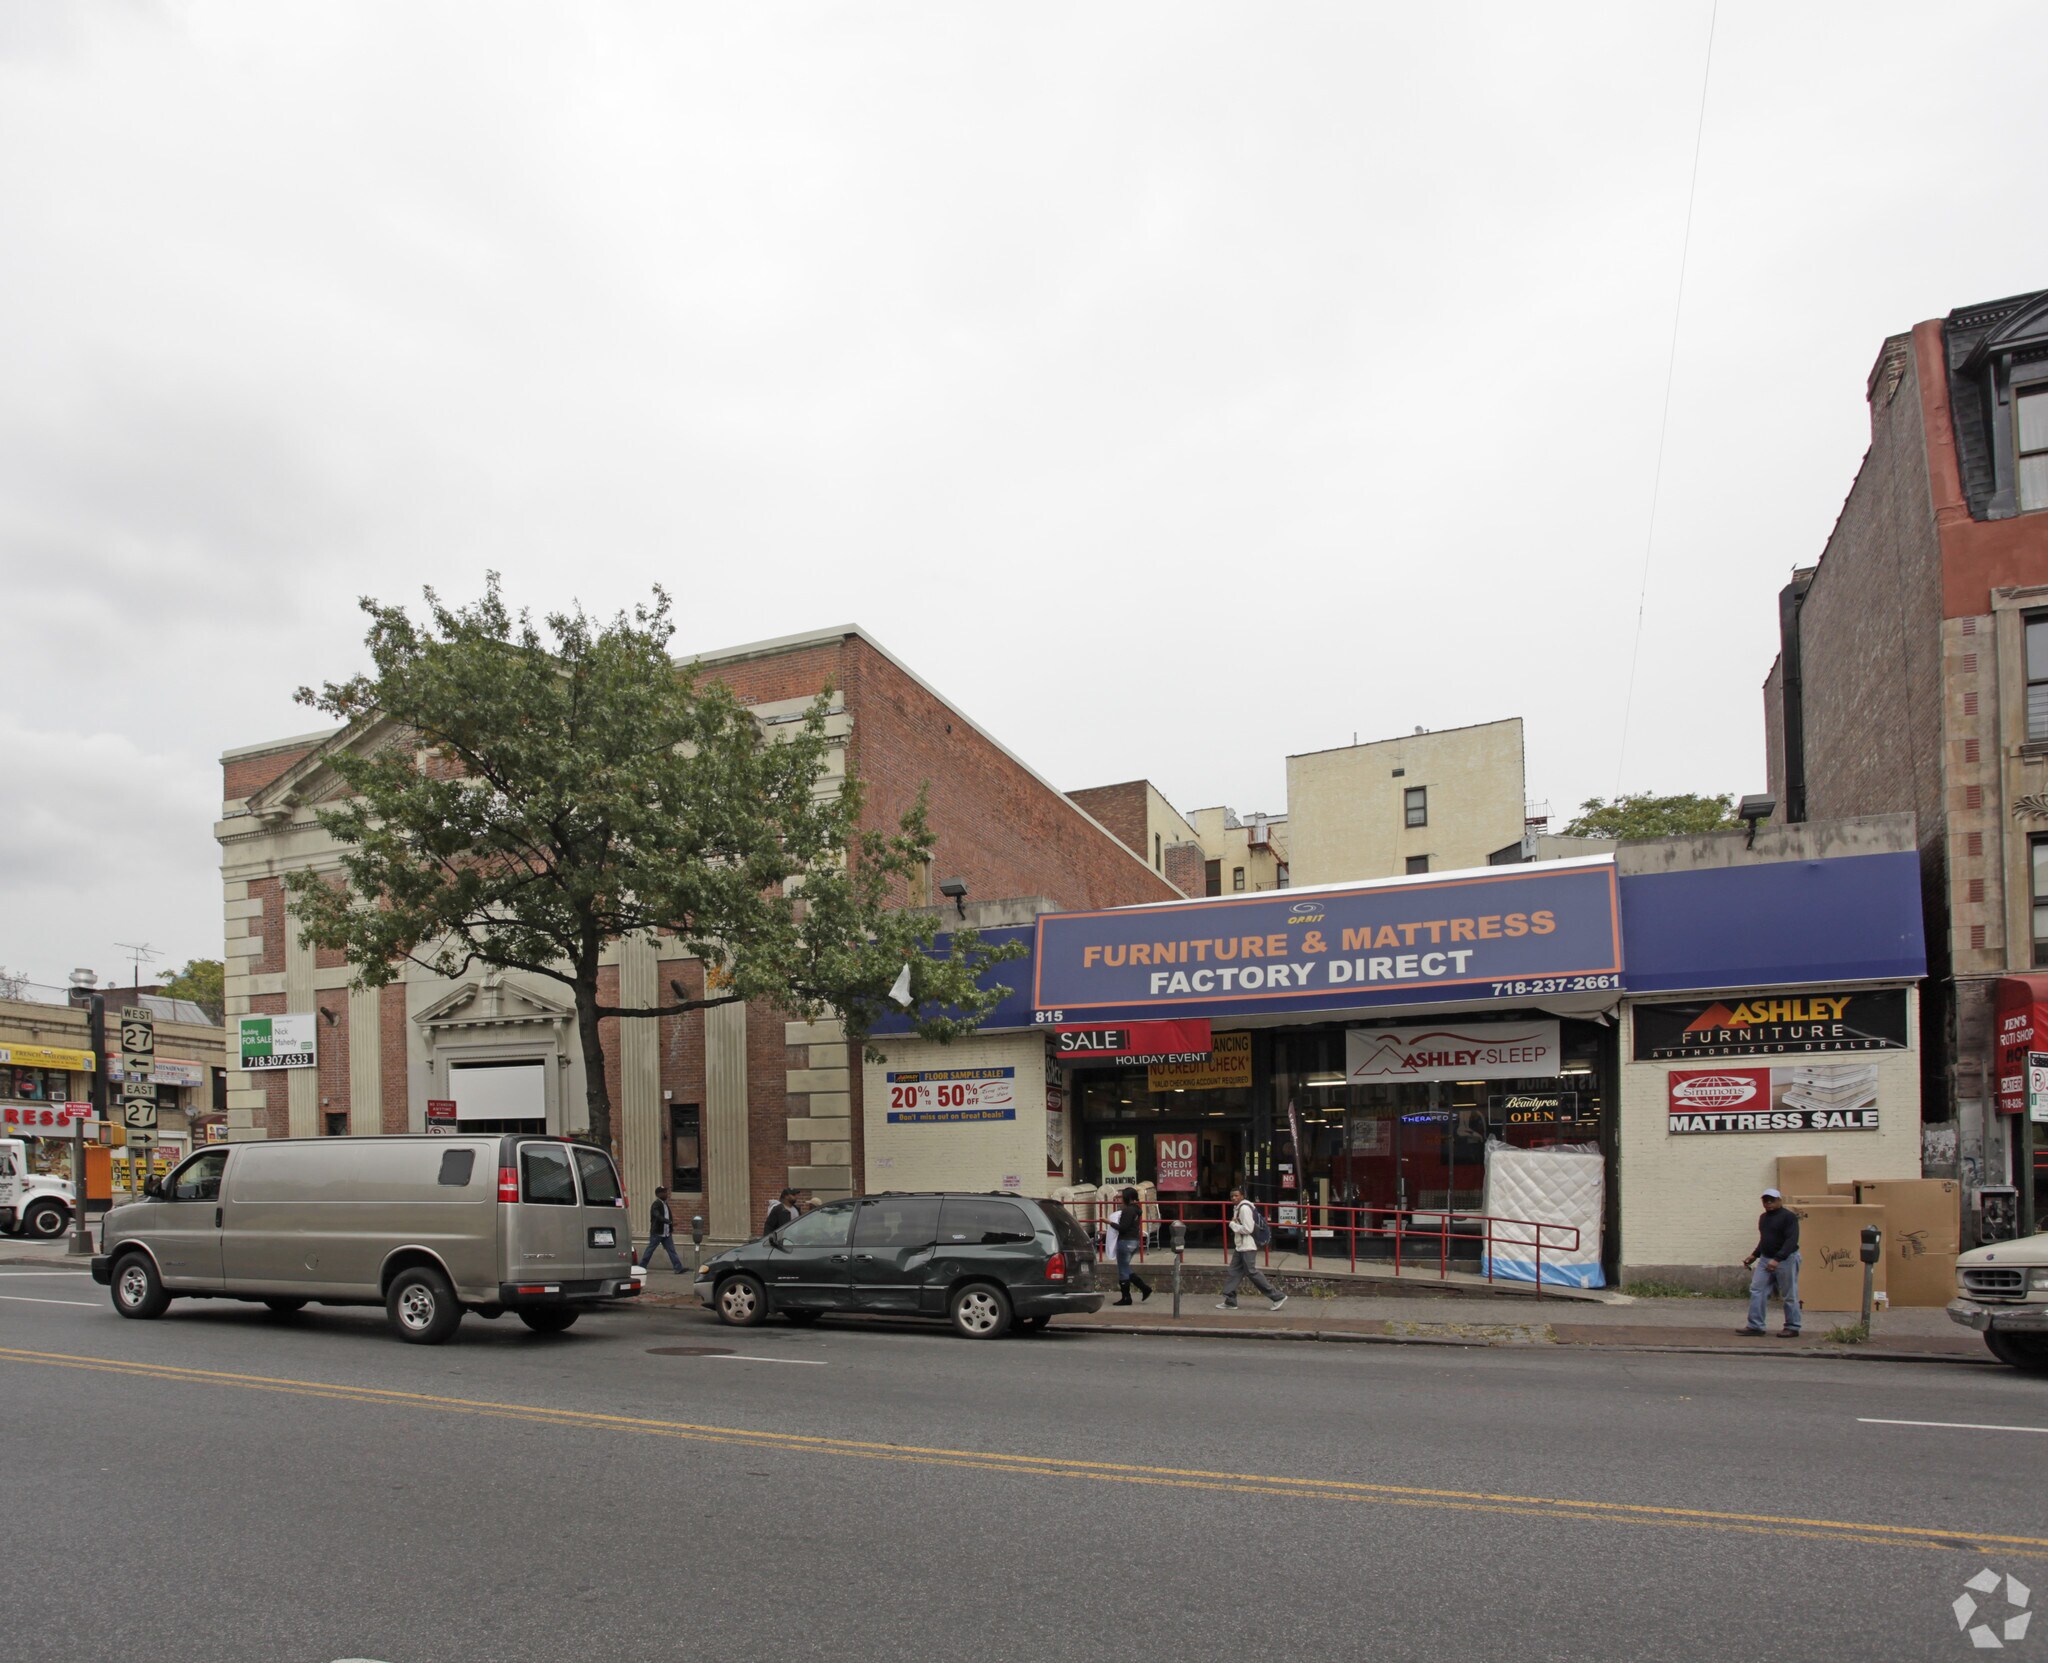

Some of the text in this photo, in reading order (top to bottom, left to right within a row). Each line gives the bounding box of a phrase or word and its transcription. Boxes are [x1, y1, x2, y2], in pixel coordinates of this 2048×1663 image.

[1287, 914, 1325, 925] ORBIT
[1083, 910, 1557, 969] FURNITURE & MATTRESS
[1150, 949, 1474, 995] FACTORY DIRECT
[1491, 974, 1620, 996] 718-237-2661
[124, 1009, 150, 1019] WEST
[1035, 1010, 1063, 1023] 815
[1727, 996, 1852, 1025] ASHLEY
[2004, 1014, 2027, 1031] JEN'S
[123, 1029, 150, 1047] 27
[242, 1035, 272, 1044] FOR SALE
[1682, 1024, 1844, 1044] FURNITURE
[2000, 1027, 2034, 1046] ROTI SHOP
[1213, 1036, 1249, 1052] ANCING
[1652, 1040, 1886, 1058] AUTHORIZED DEALER
[248, 1054, 309, 1067] 718.307.6533
[1116, 1052, 1207, 1066] HOLIDAY EVENT
[924, 1069, 1004, 1080] FLOOR SAMPLE SALE!
[1150, 1063, 1164, 1075] NO
[1168, 1062, 1206, 1074] CREDIT
[1170, 1078, 1196, 1087] CHECKING
[1196, 1077, 1221, 1086] ACCOUNT
[1222, 1076, 1249, 1084] REQUIRED
[127, 1085, 153, 1095] EAST
[891, 1085, 930, 1108] 20%
[937, 1083, 978, 1107] 50%
[1683, 1085, 1745, 1097] Simmons
[1505, 1096, 1559, 1111] Beautyres
[4, 1108, 70, 1126] RESS
[128, 1105, 154, 1121] 27
[899, 1113, 916, 1121] Don't
[982, 1110, 1005, 1118] Deals!
[1402, 1114, 1458, 1123] THERAPED
[1510, 1112, 1555, 1122] OPEN
[1669, 1109, 1878, 1132] MATTRESS $ALE
[1161, 1140, 1193, 1159] NO
[1162, 1169, 1193, 1178] CHECK
